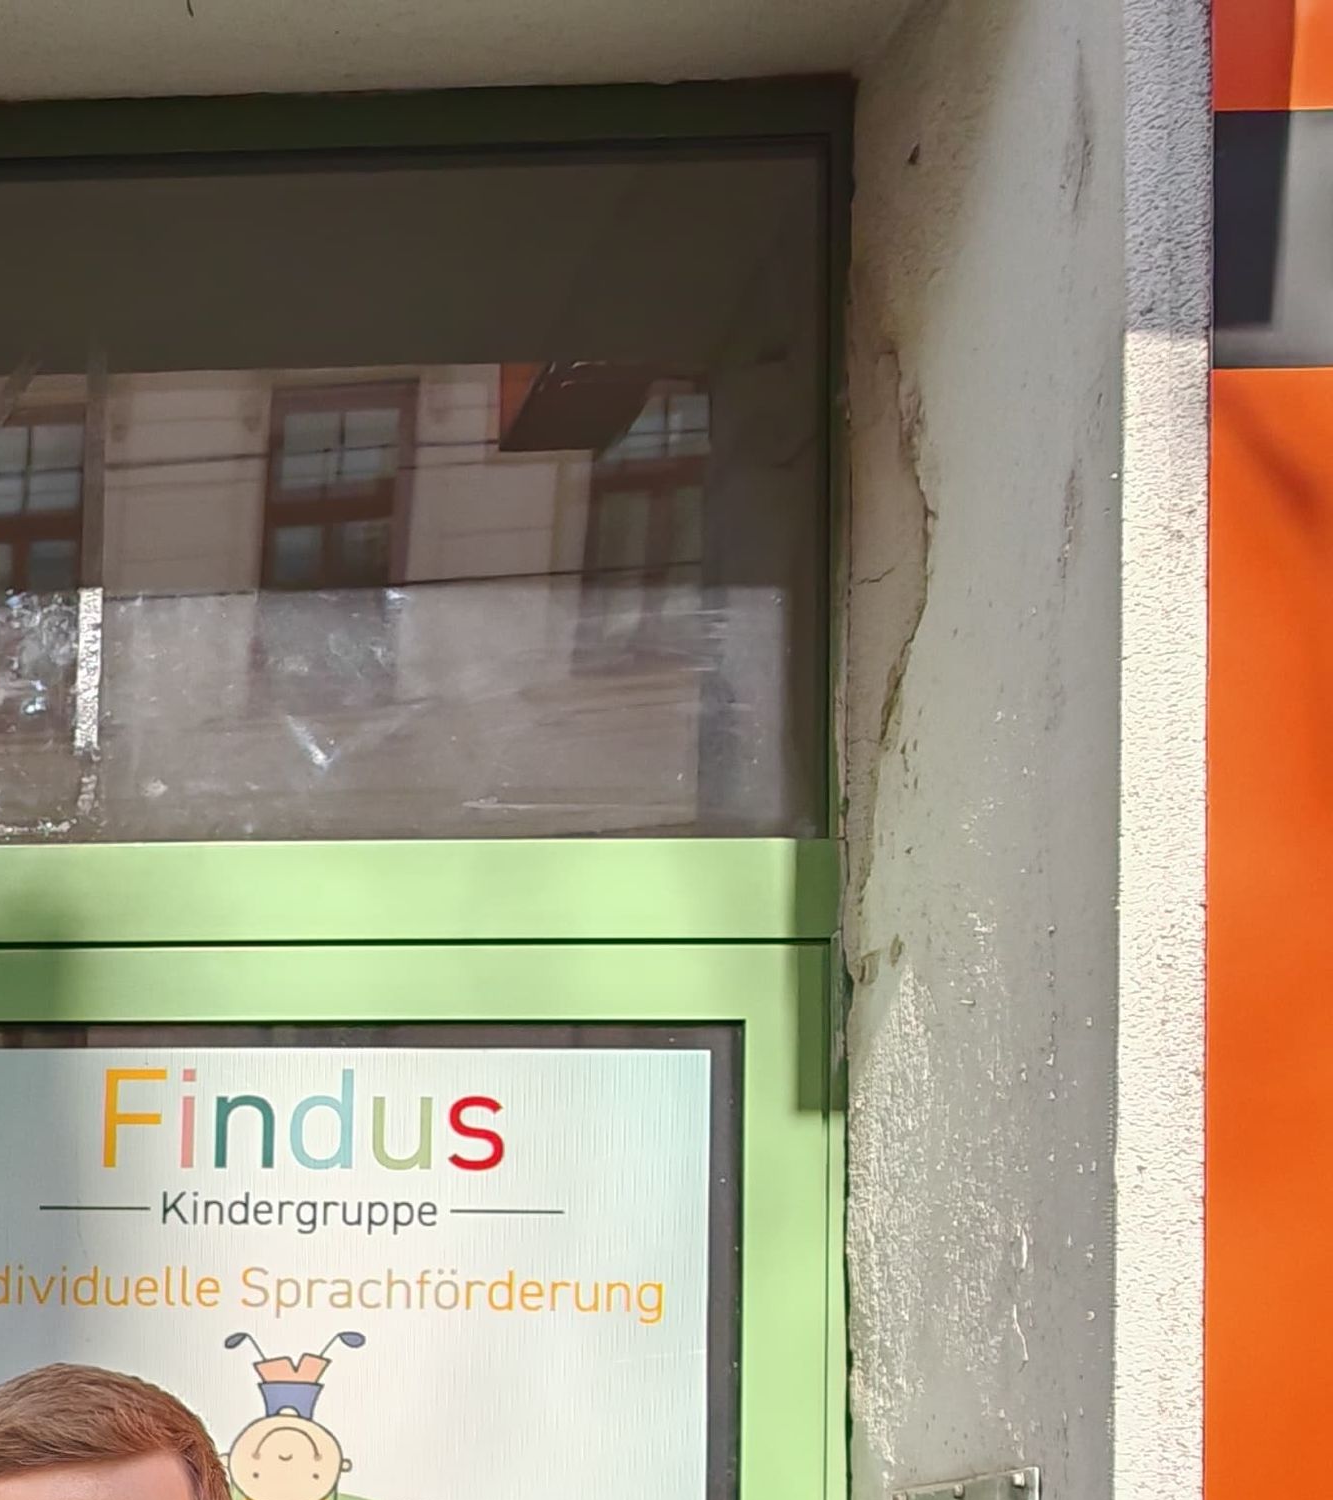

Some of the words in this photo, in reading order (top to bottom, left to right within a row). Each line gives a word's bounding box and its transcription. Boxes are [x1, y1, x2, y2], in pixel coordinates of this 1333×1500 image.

[102, 1068, 505, 1171] Findus
[161, 1192, 438, 1234] Kindergruppe
[240, 1267, 665, 1322] Sprachförderung
